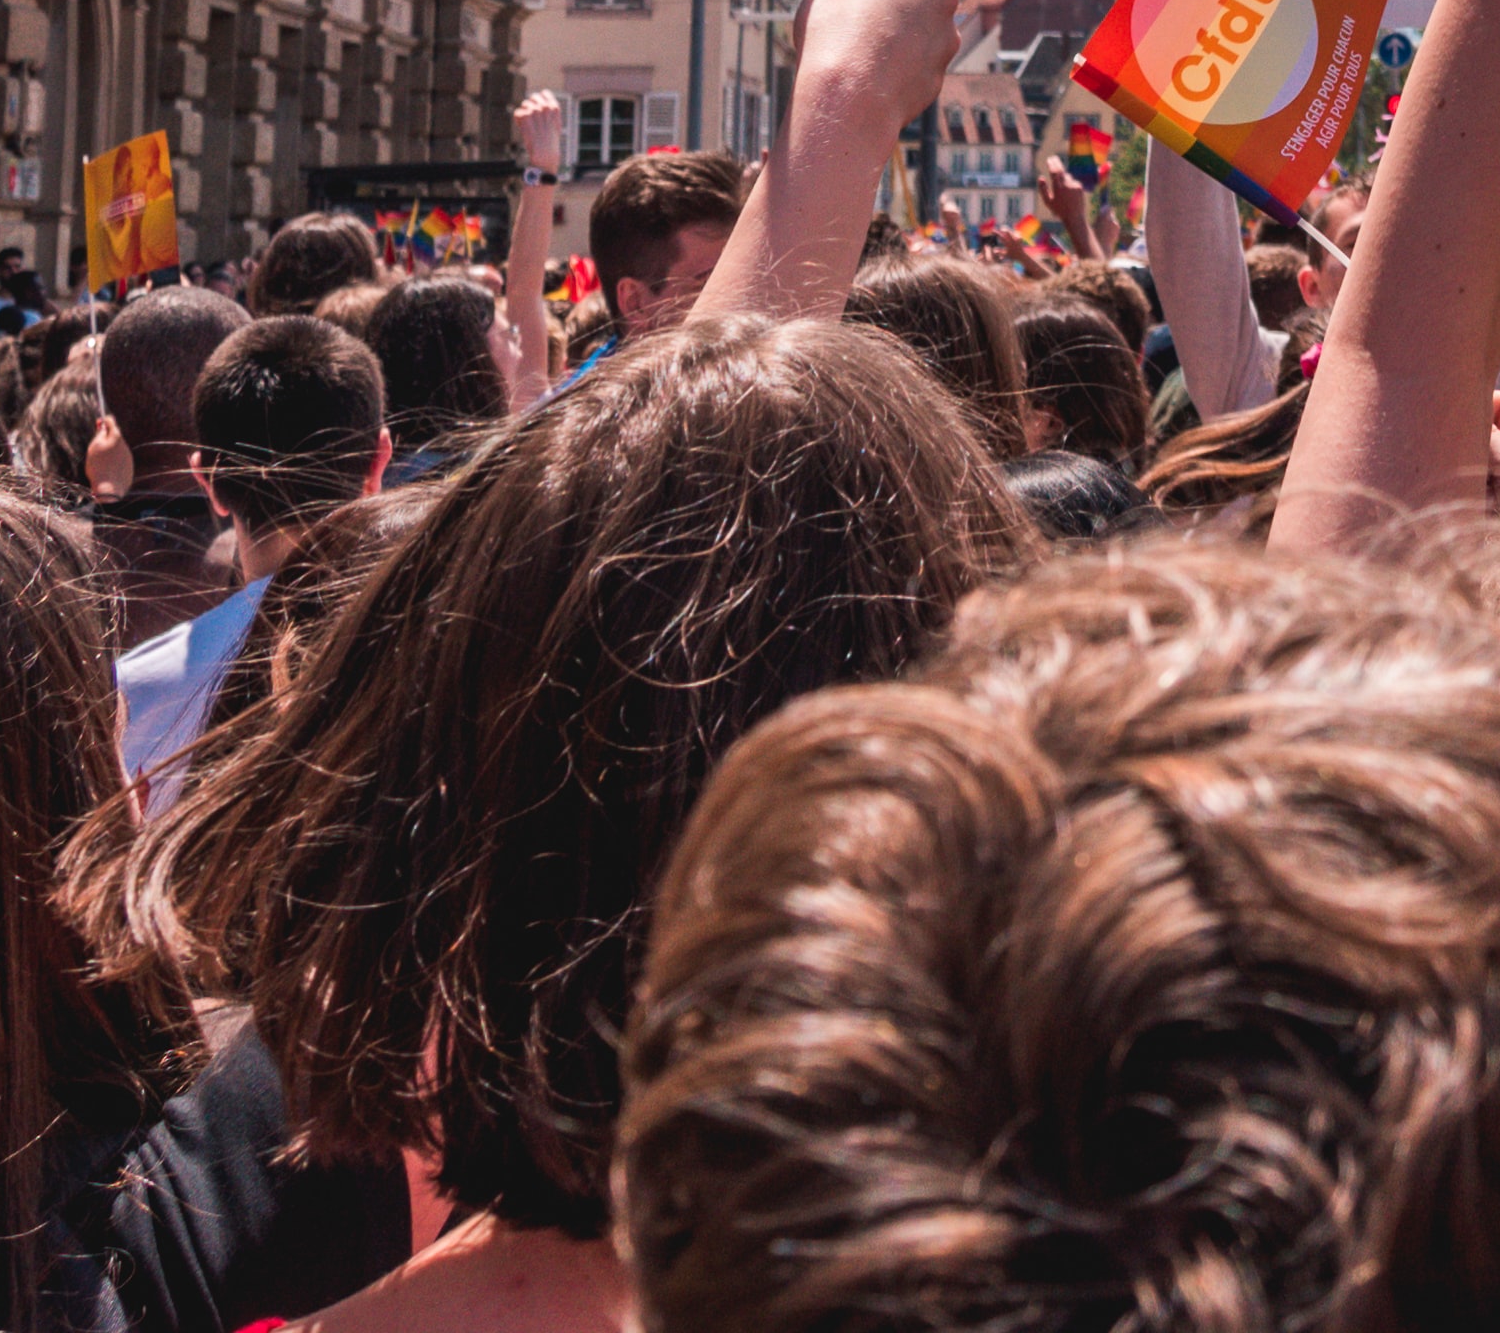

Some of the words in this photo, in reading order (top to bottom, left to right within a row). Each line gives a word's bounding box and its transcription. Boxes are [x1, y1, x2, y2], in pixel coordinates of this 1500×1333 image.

[1280, 98, 1327, 161] S'ENGAGER
[1318, 63, 1341, 101] POUR
[1332, 14, 1356, 65] CHACUN
[1315, 117, 1340, 149] AGIR
[1330, 82, 1354, 119] POUR
[1343, 49, 1363, 83] TOUS
